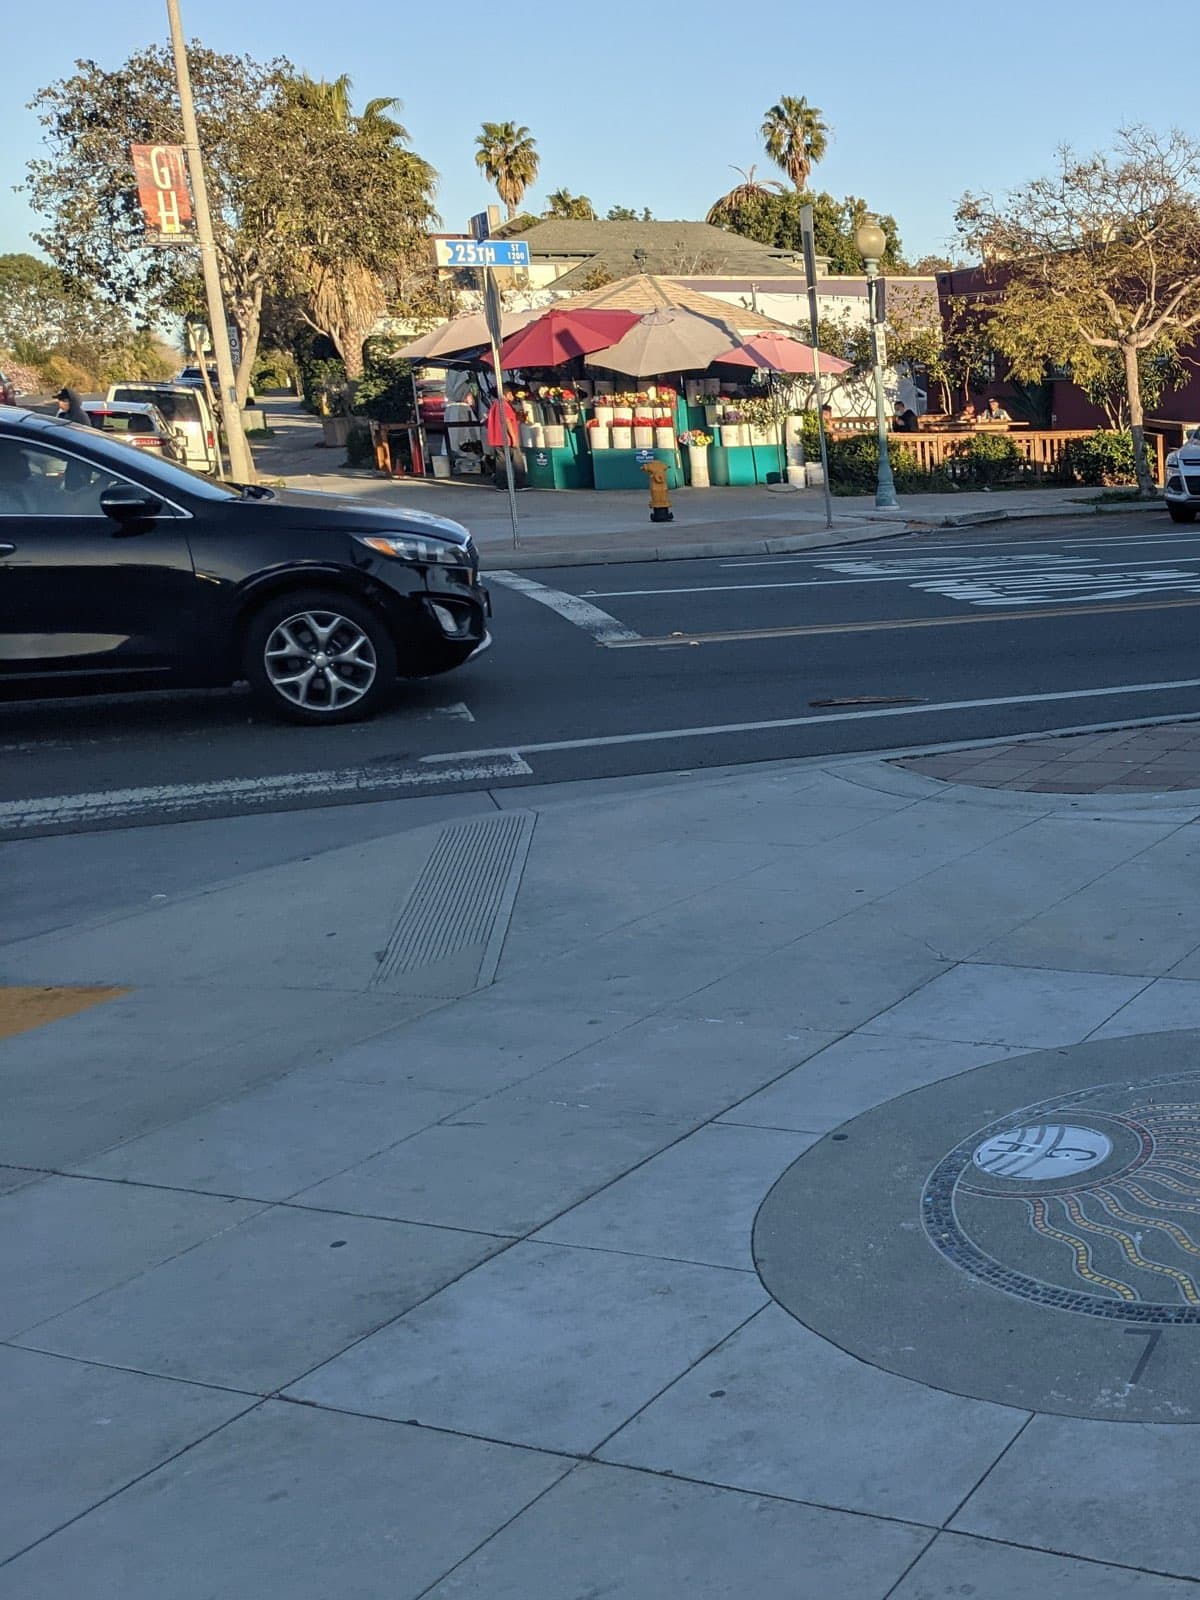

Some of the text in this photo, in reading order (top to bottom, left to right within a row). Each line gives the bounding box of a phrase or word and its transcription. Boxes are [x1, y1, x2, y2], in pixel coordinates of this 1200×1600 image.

[455, 244, 519, 262] 25TH ST
[507, 252, 525, 260] 1200
